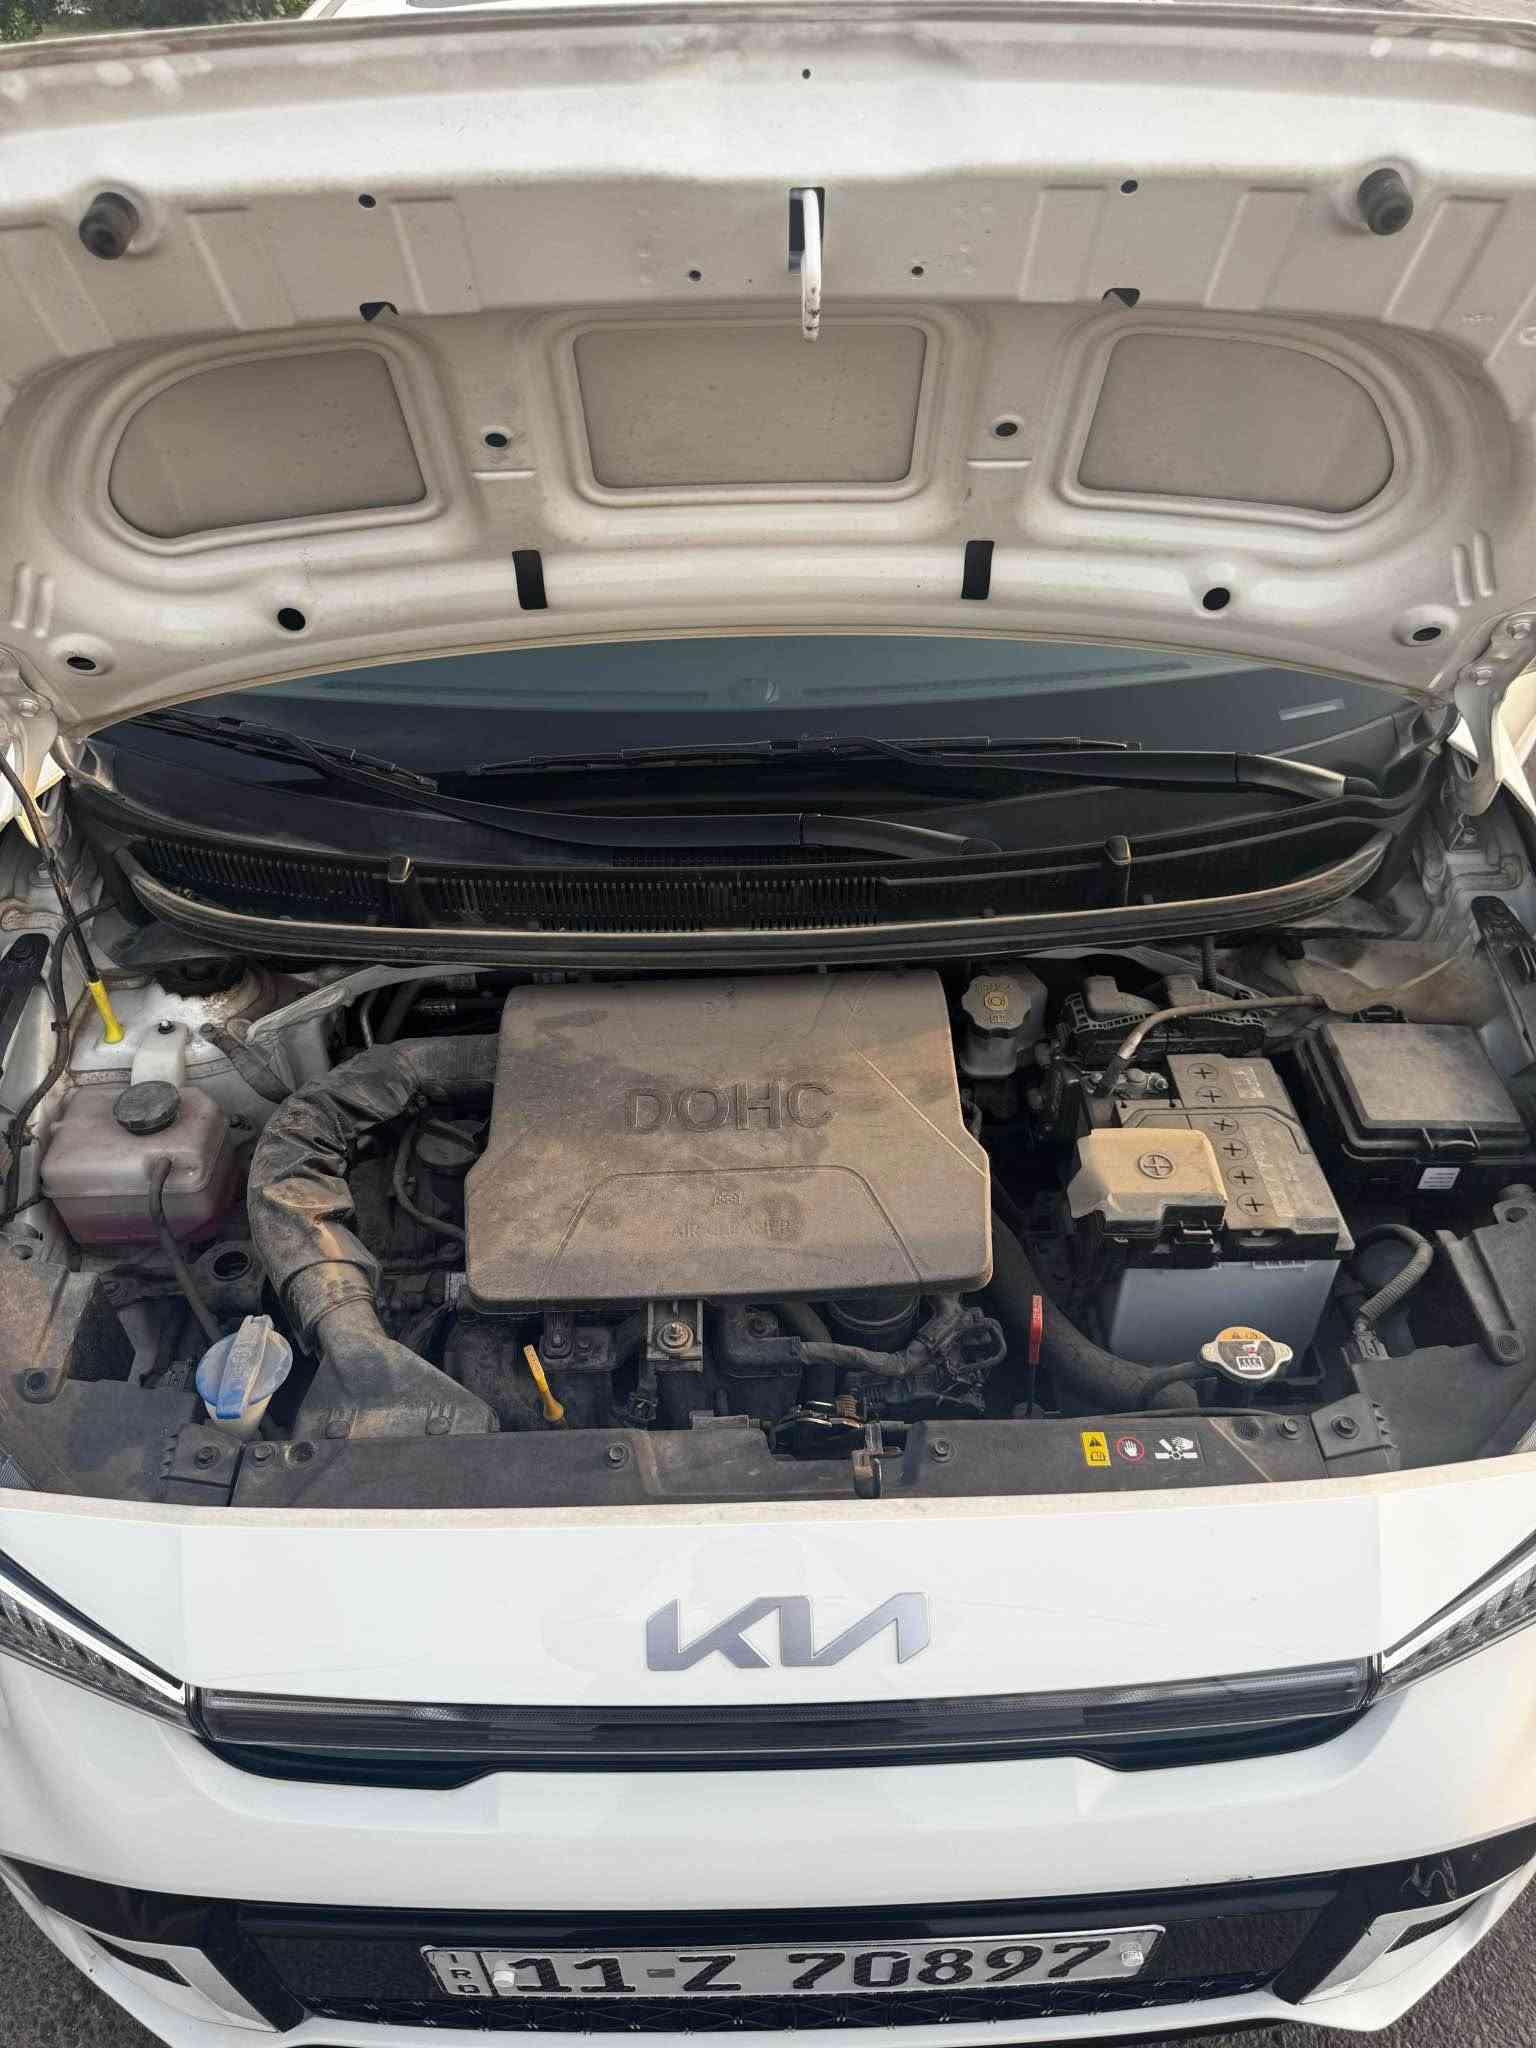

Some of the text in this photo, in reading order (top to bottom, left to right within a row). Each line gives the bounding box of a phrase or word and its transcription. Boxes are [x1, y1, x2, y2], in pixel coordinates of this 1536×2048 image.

[625, 1081, 834, 1130] DOHC
[647, 1592, 930, 1671] KIA
[788, 1940, 1111, 1989] 70897
